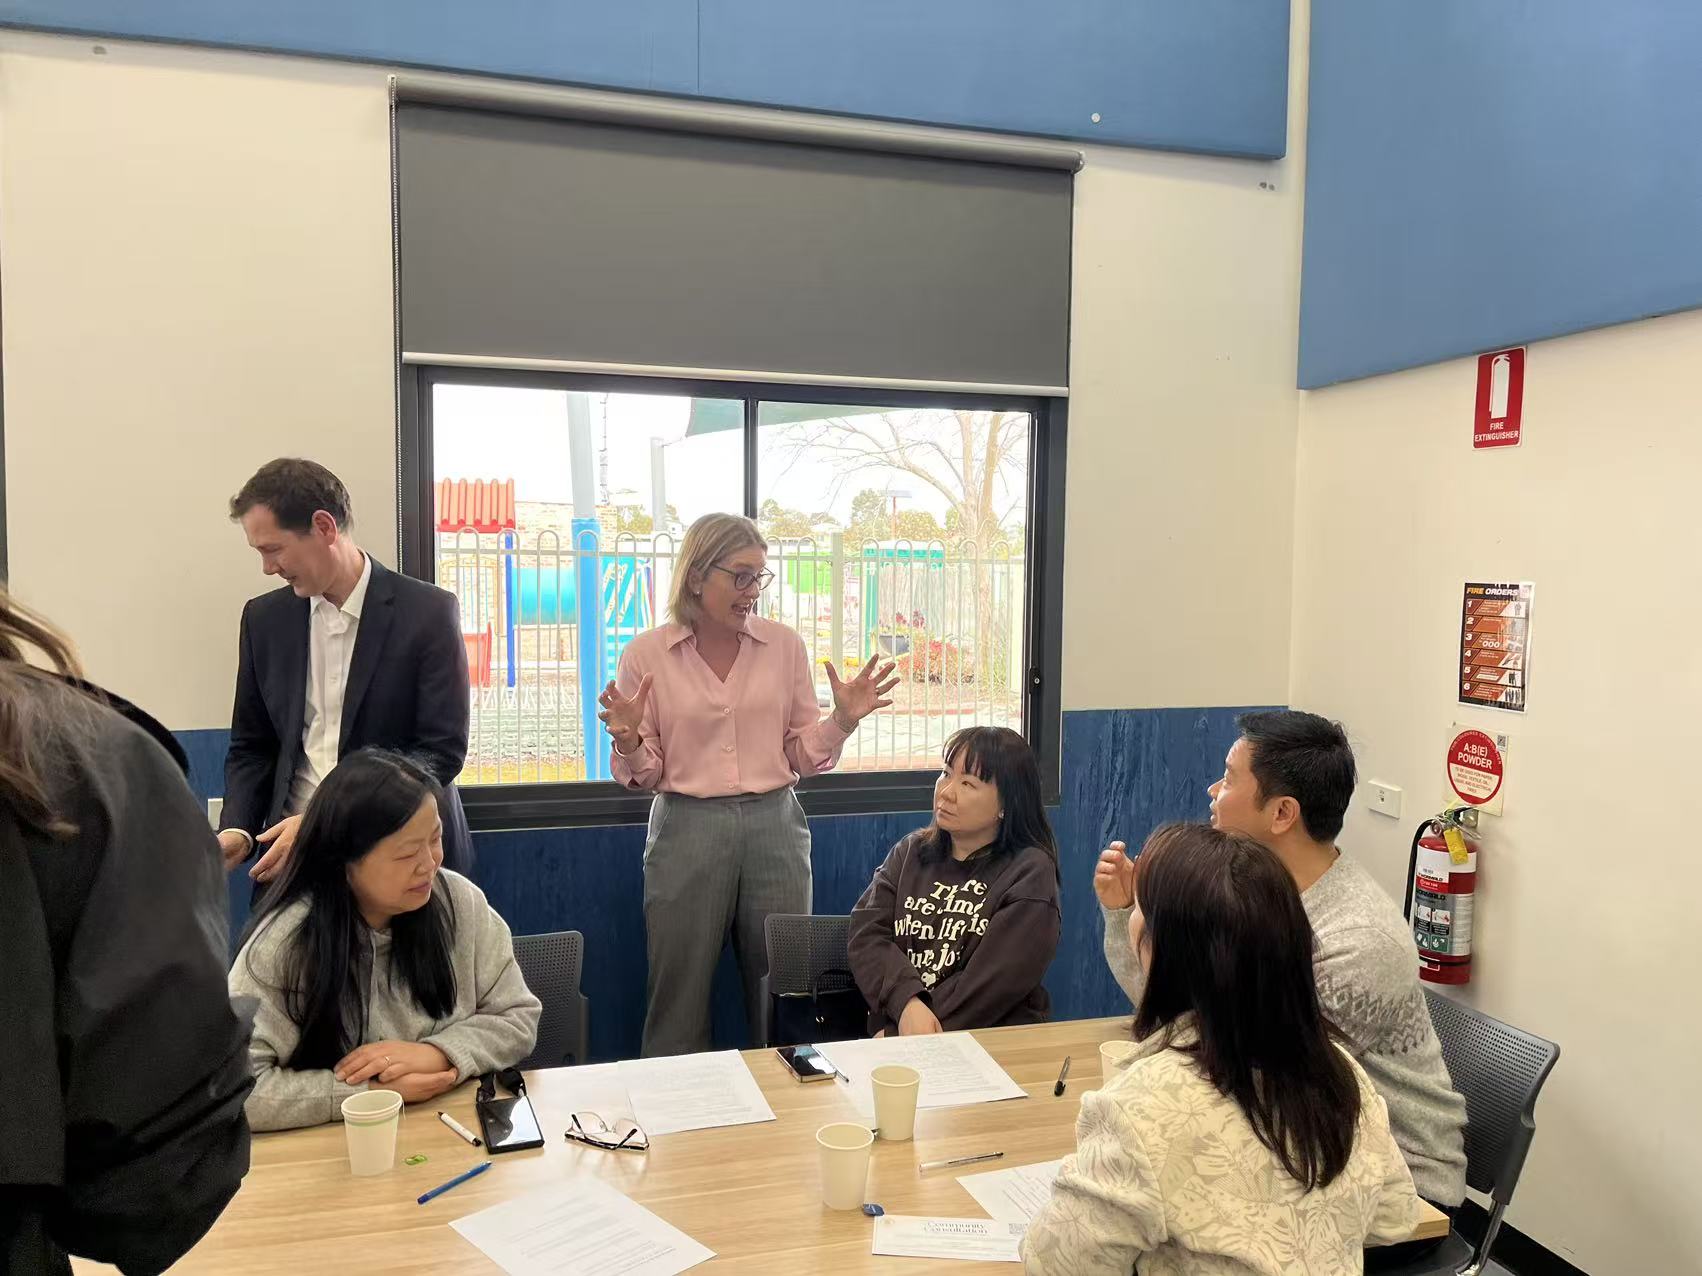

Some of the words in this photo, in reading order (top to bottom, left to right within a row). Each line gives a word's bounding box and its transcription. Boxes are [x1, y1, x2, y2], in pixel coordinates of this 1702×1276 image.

[1490, 422, 1504, 430] FIRE
[1475, 430, 1519, 442] EXTINGUISHER
[1466, 587, 1484, 595] FIRE
[1485, 588, 1519, 596] ORDERS
[1467, 617, 1474, 625] 2
[1466, 633, 1472, 641] 3
[1482, 640, 1500, 648] 000
[1464, 666, 1471, 674] 5
[1464, 682, 1470, 690] 6
[1463, 742, 1488, 758] A:B(E)
[1457, 751, 1493, 770] POWDER
[930, 879, 988, 900] Thre
[904, 896, 936, 915] are
[968, 913, 989, 936] is
[932, 942, 961, 972] jo
